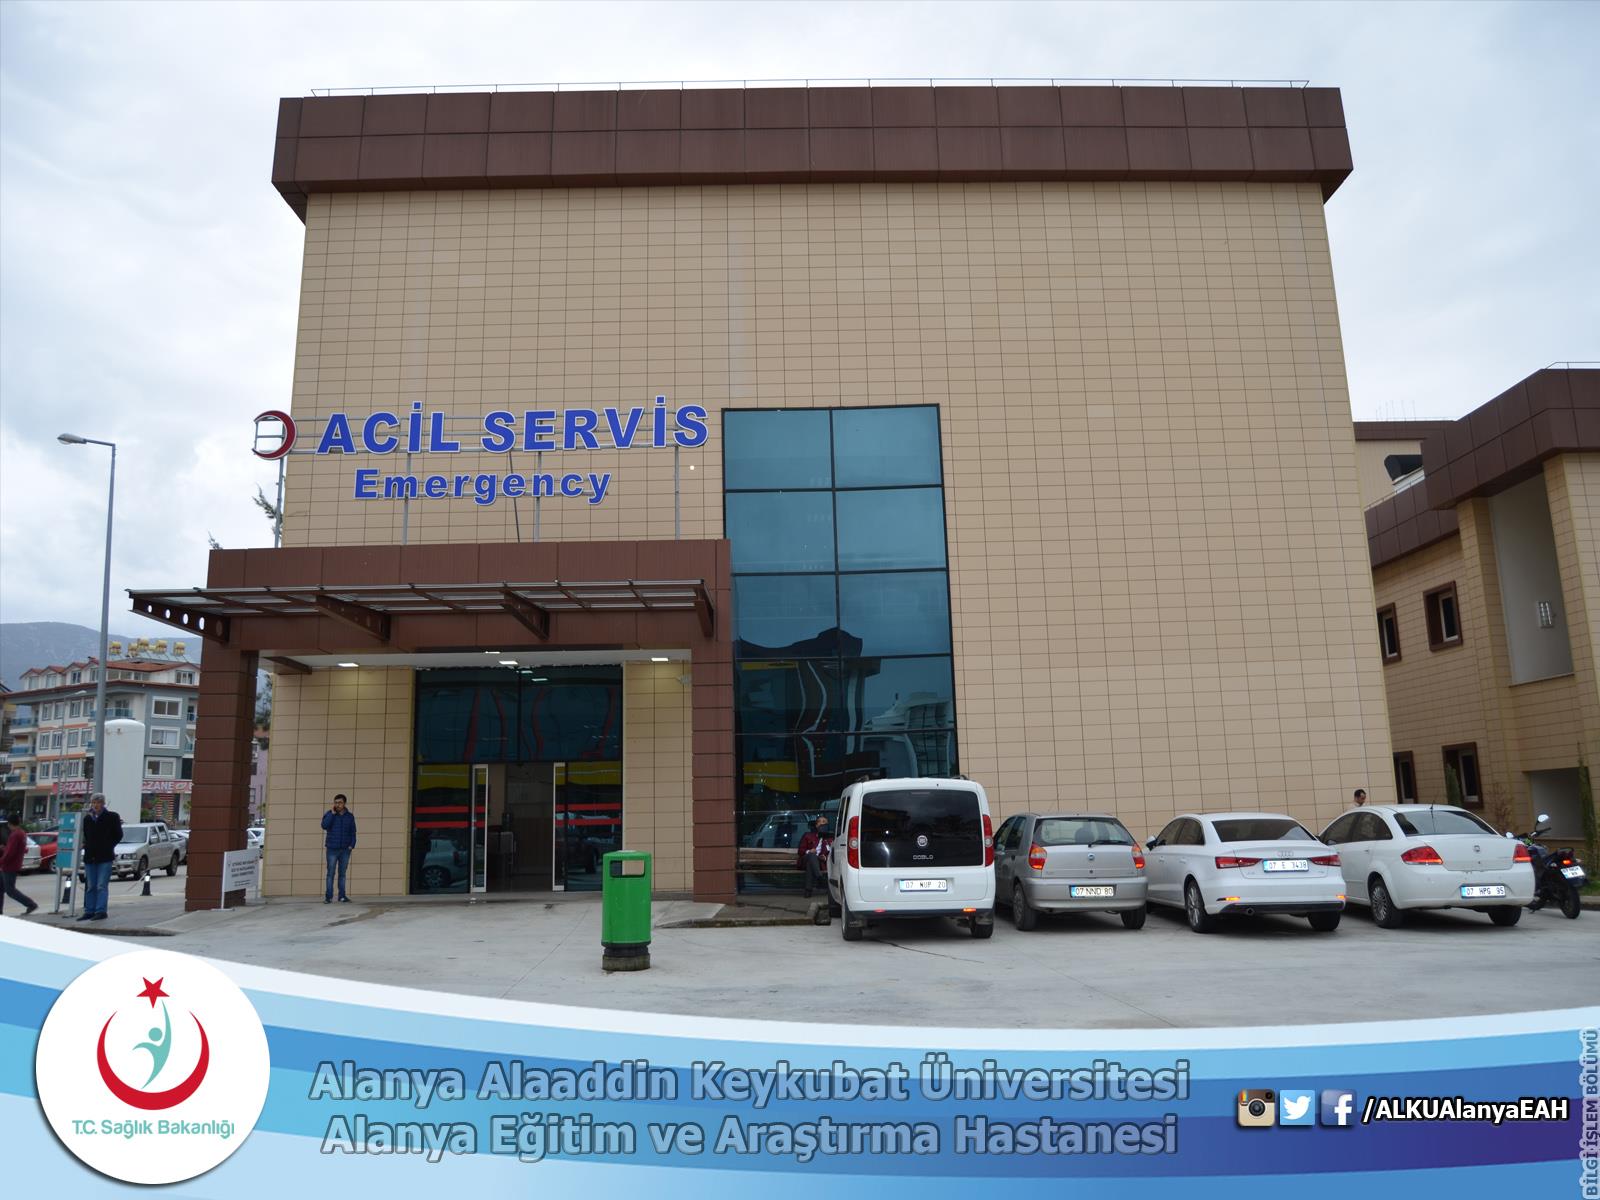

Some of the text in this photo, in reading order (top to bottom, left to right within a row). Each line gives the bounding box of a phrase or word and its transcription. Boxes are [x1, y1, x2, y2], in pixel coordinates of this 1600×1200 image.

[316, 395, 708, 454] ACİL SERVİS
[353, 468, 611, 504] Emergency
